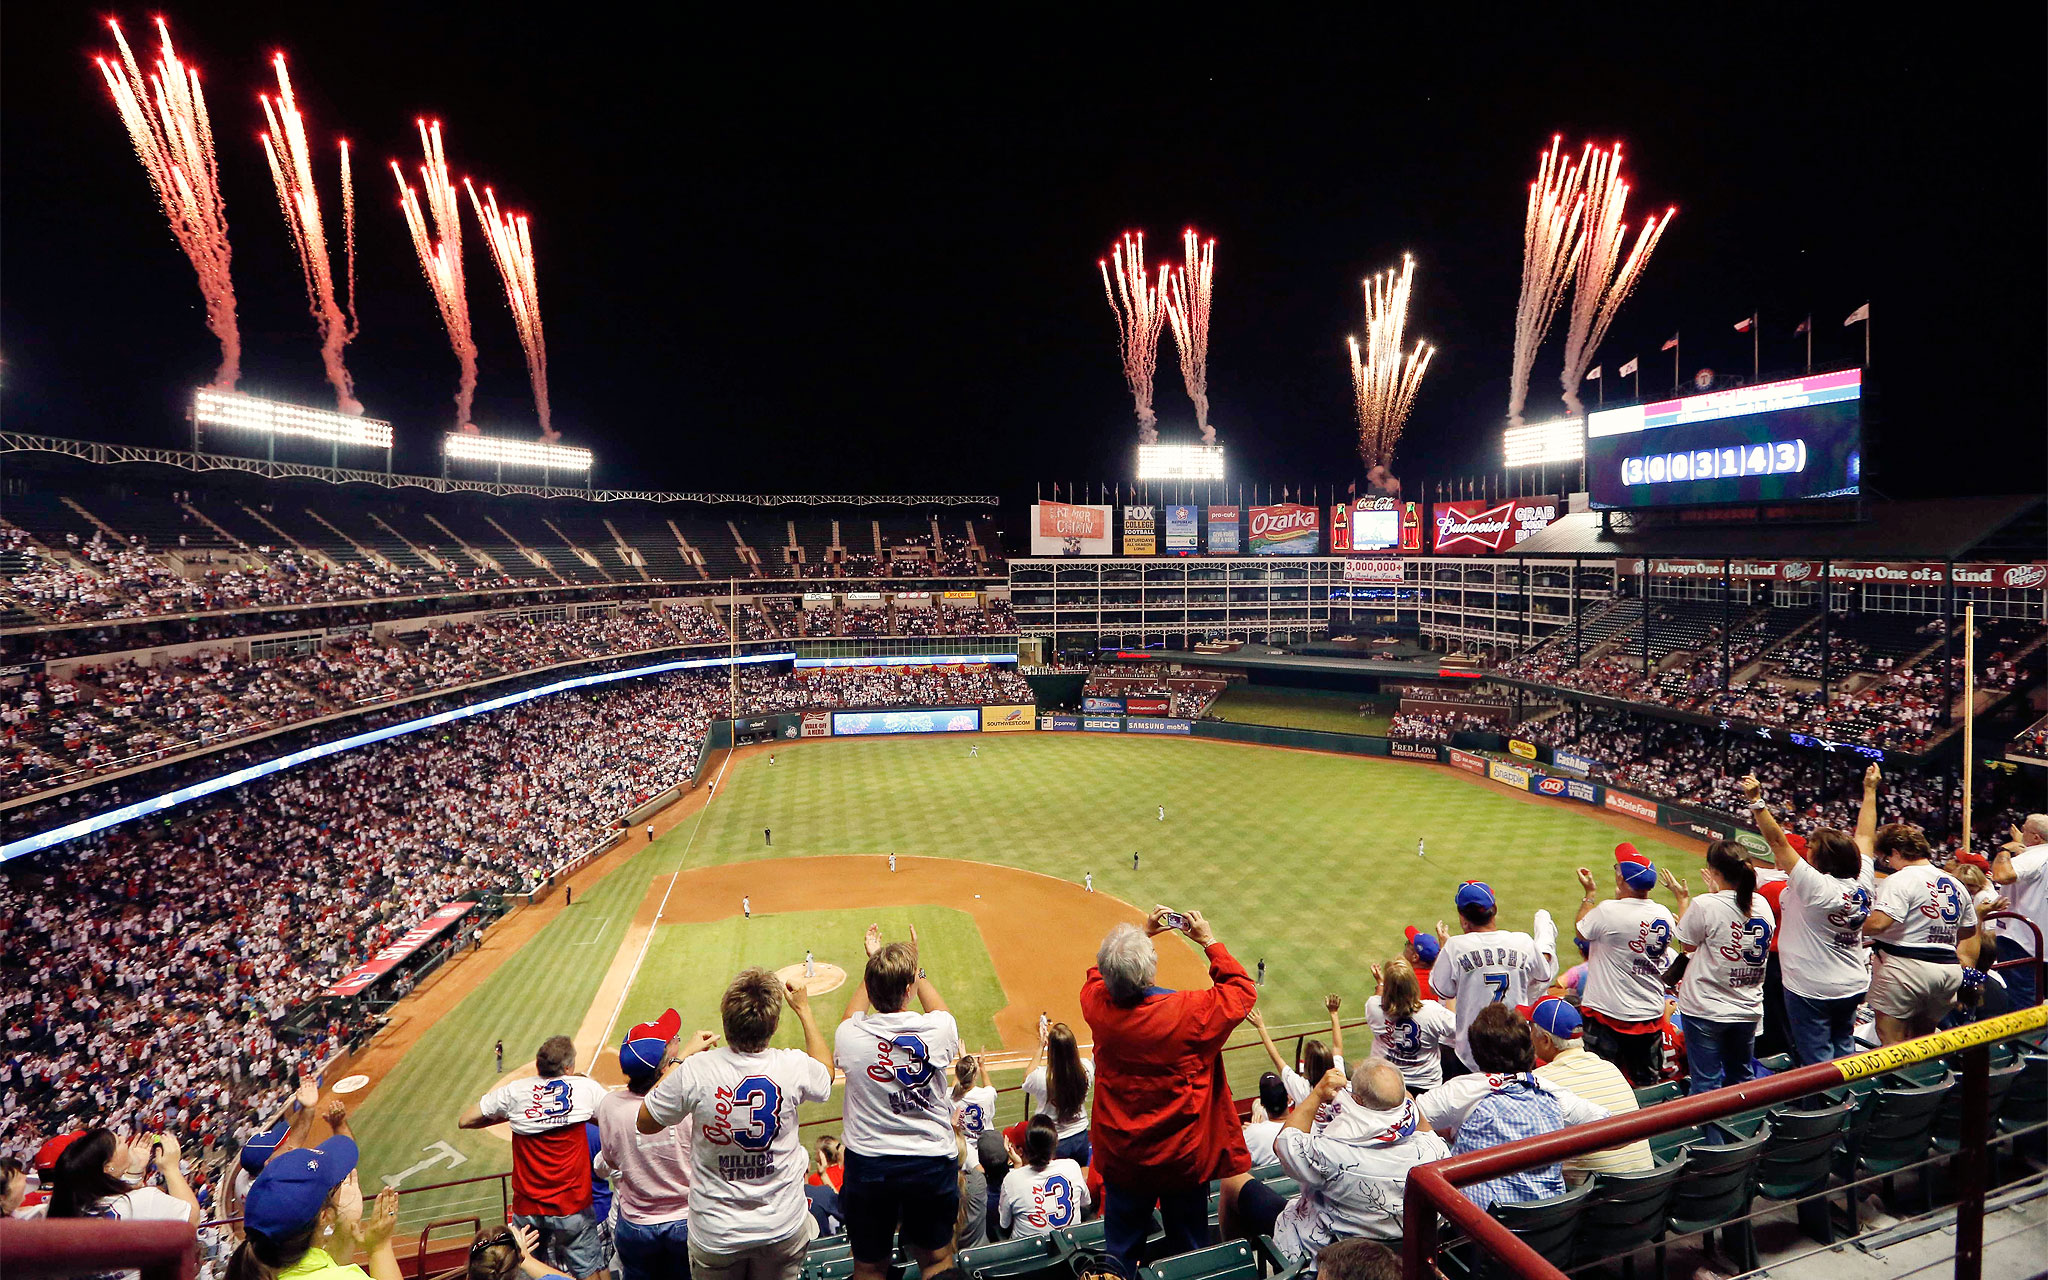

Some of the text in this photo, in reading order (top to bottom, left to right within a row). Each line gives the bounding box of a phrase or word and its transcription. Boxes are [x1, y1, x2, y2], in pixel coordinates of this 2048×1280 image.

[1125, 506, 1154, 520] FOX
[1252, 509, 1315, 535] Ozarka
[1515, 506, 1555, 521] GRAB
[1126, 521, 1154, 529] COLLEGE
[1437, 517, 1510, 535] Budweiser
[1522, 520, 1548, 530] SOME
[1656, 562, 1697, 577] Always
[1697, 563, 1720, 575] One
[1744, 562, 1777, 576] Kind
[1874, 565, 1908, 580] One
[1910, 565, 1931, 581] of
[2007, 567, 2044, 586] Pepper
[2017, 564, 2034, 576] Dr
[1084, 721, 1120, 729] GEICO
[1128, 722, 1189, 731] SAMSUNG mobile
[1392, 741, 1436, 754] FRED LOYA
[1392, 750, 1437, 760] INSURANCE
[1556, 752, 1575, 768] Cash
[1494, 765, 1524, 785] Snapple
[1544, 782, 1562, 790] DQ
[1691, 823, 1724, 840] verizon
[1920, 875, 1963, 925] Over 3
[1827, 892, 1852, 928] Over
[1628, 916, 1672, 959] Over 3
[1720, 916, 1773, 967] Over 3
[1483, 972, 1510, 1005] 7
[1394, 1016, 1421, 1056] 3
[1841, 1060, 1862, 1077] DO
[1861, 1053, 1887, 1072] NOT
[1886, 1046, 1921, 1067] LEAN,
[1917, 1039, 1936, 1055] SIT
[1954, 1031, 1970, 1045] OR
[1972, 1021, 2004, 1040] STAND
[890, 1034, 937, 1090] 3
[524, 1078, 574, 1119] Over 3
[702, 1074, 784, 1152] Over 3
[965, 1103, 985, 1133] 3
[719, 1151, 774, 1169] MILLION
[1027, 1173, 1075, 1230] Over 3
